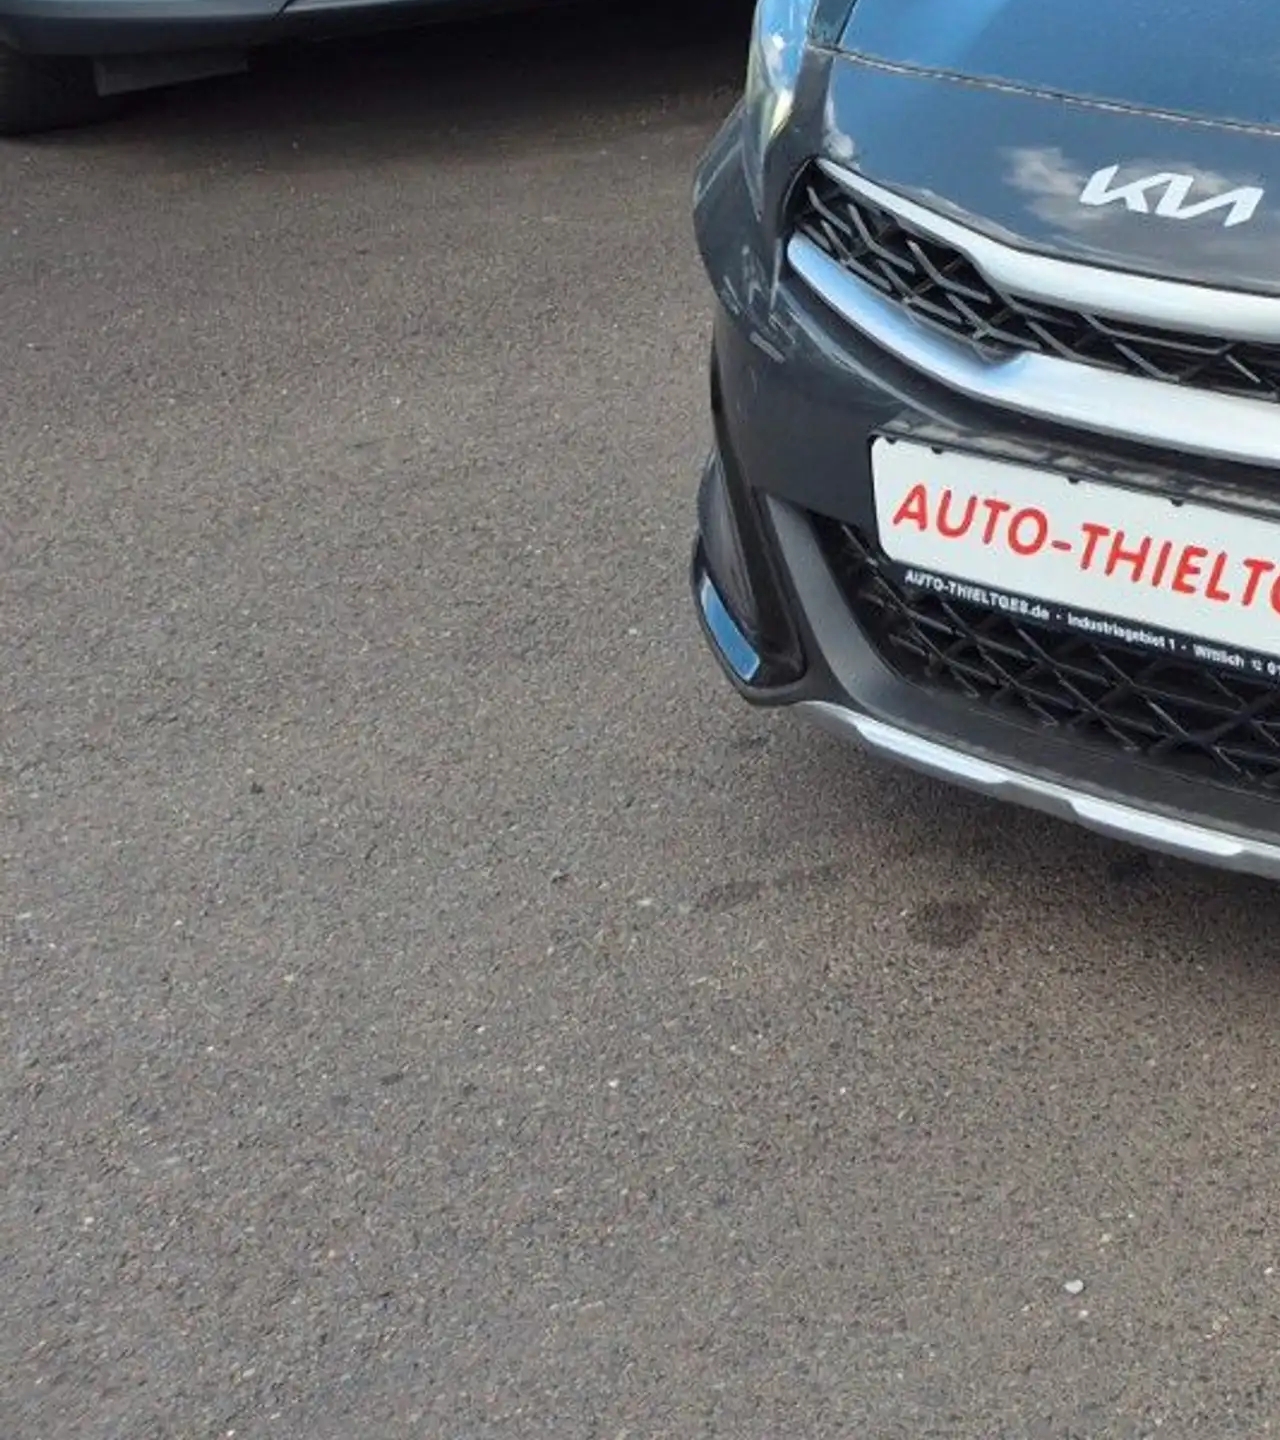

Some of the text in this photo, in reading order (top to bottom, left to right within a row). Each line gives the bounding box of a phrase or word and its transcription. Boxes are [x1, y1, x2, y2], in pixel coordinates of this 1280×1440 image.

[1079, 163, 1265, 228] KIA
[904, 568, 1050, 621] AUTO-THIELTGES.de
[1193, 644, 1245, 669] Wittlich
